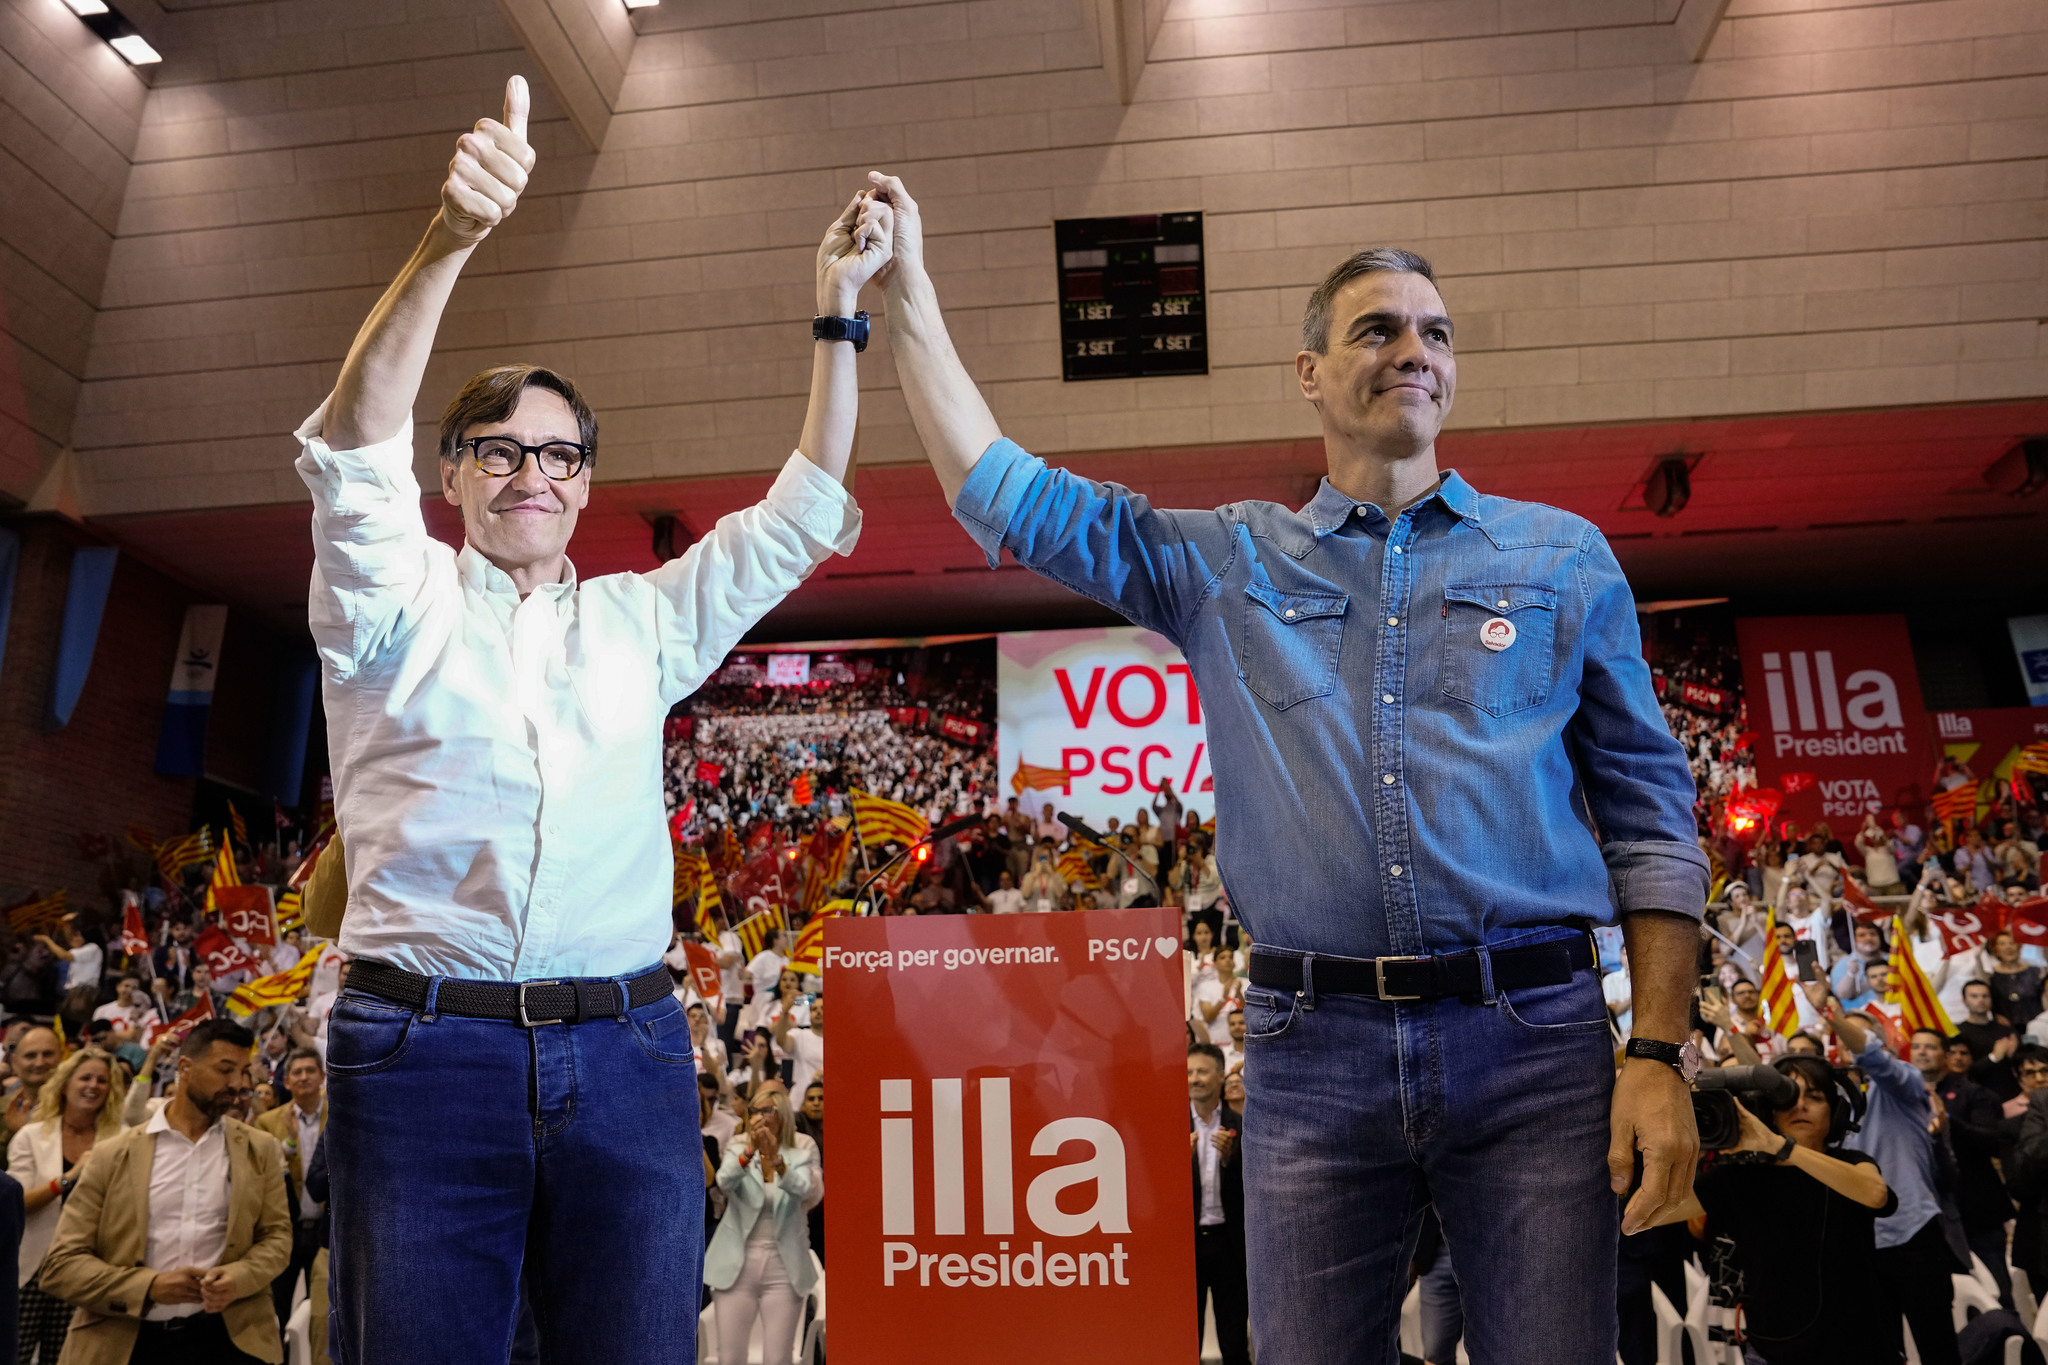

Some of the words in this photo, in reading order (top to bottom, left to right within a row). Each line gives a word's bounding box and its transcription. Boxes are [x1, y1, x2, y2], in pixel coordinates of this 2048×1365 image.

[1078, 307, 1085, 321] 1
[1087, 304, 1114, 320] SET
[1152, 302, 1162, 317] 3
[1164, 301, 1190, 316] SET
[1077, 342, 1087, 357] 2
[1088, 340, 1115, 356] SET
[1153, 337, 1164, 351] 4
[1166, 335, 1192, 350] SET
[1762, 650, 1906, 732] illa
[1773, 731, 1908, 759] President
[1818, 779, 1881, 801] VOTA
[825, 946, 893, 973] Força
[898, 948, 939, 971] per
[943, 945, 1060, 971] governar.
[880, 1077, 1133, 1237] illa
[883, 1241, 1130, 1288] President
